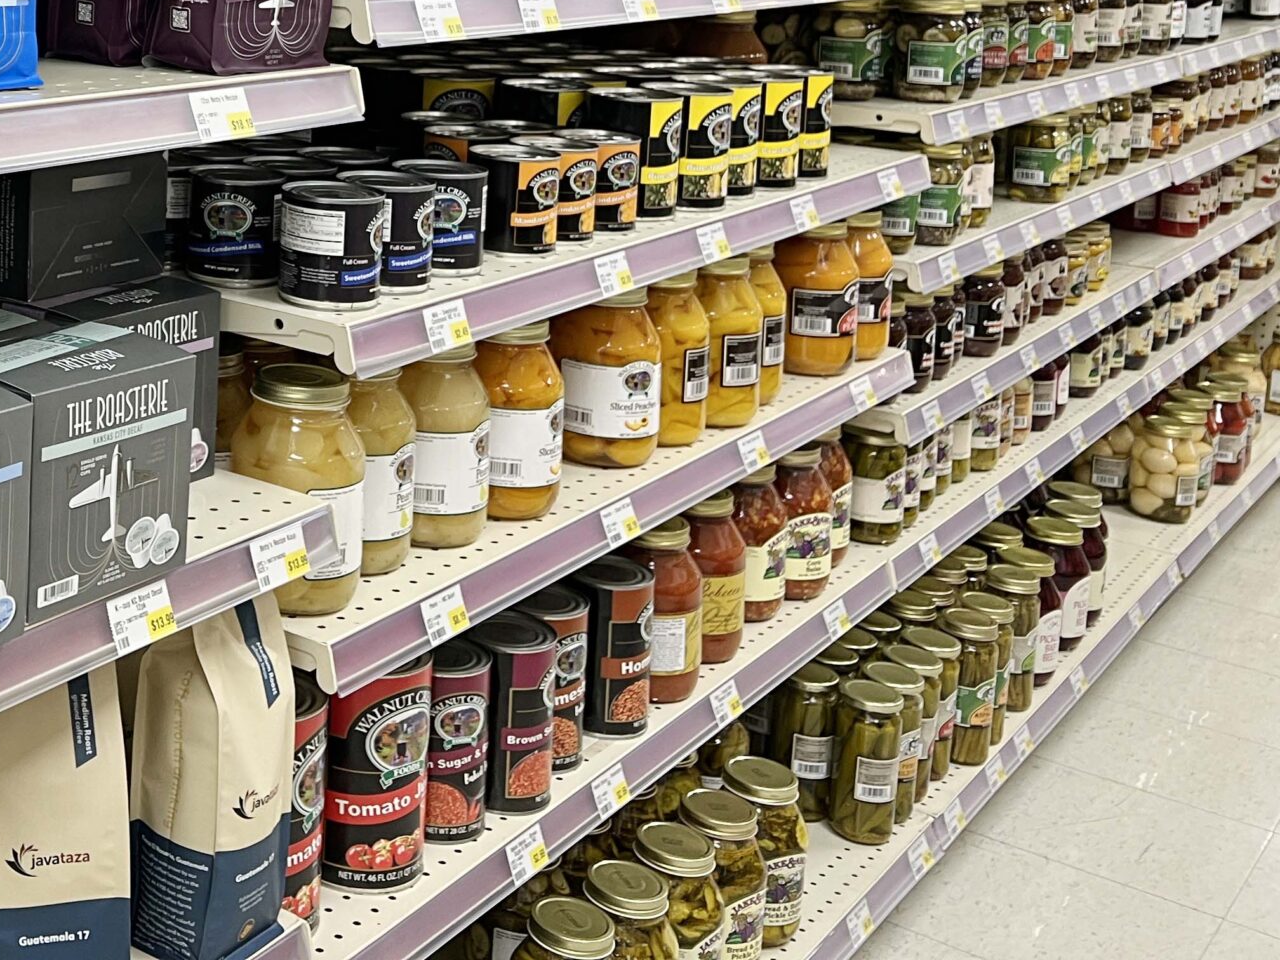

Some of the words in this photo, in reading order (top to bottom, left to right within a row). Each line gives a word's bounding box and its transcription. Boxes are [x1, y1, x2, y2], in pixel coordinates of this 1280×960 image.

[231, 193, 258, 214] CREEK
[96, 379, 169, 430] ROASTERIE
[67, 398, 93, 438] THE
[151, 612, 175, 631] $13.99
[79, 693, 91, 724] Medium
[355, 692, 416, 735] WALNUT
[82, 724, 94, 755] Roast
[506, 732, 544, 746] Brown
[437, 753, 473, 769] Sugar
[335, 794, 412, 816] Tomato
[29, 851, 90, 870] javataza
[18, 931, 75, 947] Guatemala
[77, 930, 90, 942] 17
